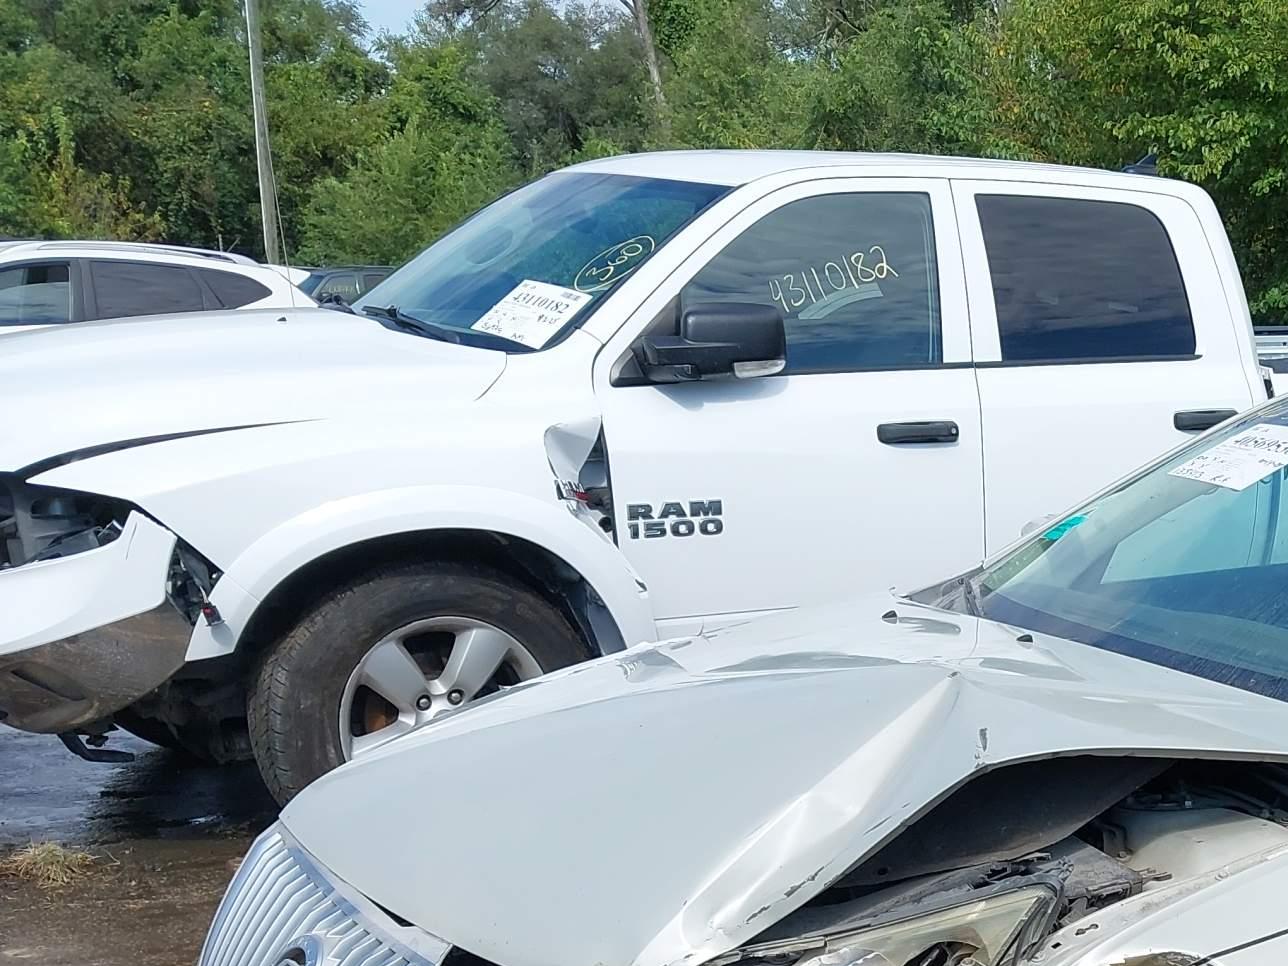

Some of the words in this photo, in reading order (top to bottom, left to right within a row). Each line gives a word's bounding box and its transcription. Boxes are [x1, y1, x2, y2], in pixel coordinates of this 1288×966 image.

[585, 243, 643, 281] 360
[768, 246, 898, 312] 43110182
[513, 292, 570, 314] 43110182
[626, 499, 723, 521] RAM
[627, 518, 724, 539] 1500
